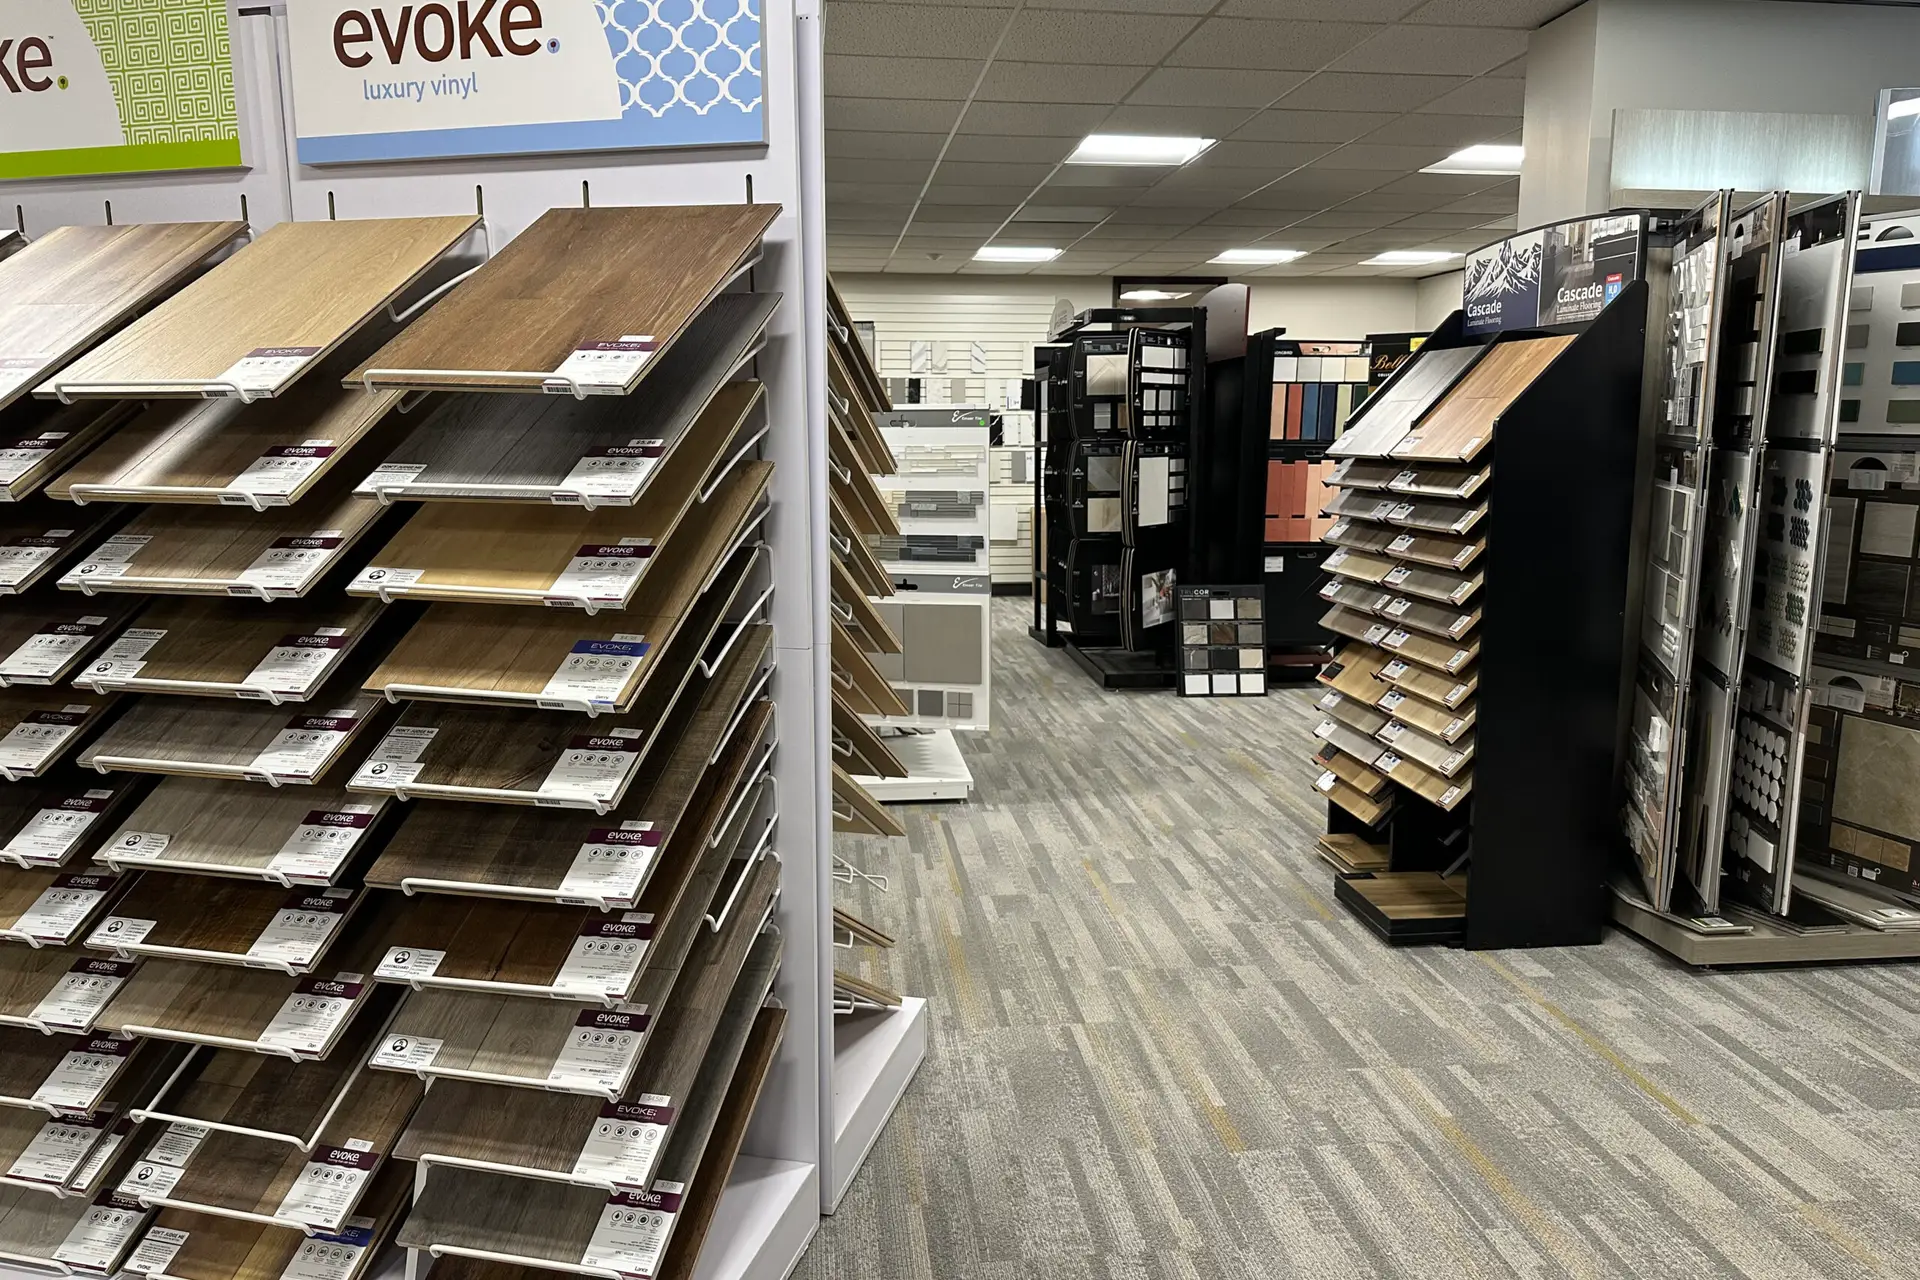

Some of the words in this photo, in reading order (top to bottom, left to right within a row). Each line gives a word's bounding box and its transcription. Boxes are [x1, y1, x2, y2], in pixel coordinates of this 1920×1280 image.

[363, 79, 426, 103] luxury
[430, 71, 478, 100] vinyl
[1557, 281, 1603, 303] Cascade
[1467, 299, 1502, 318] Cascade
[1556, 303, 1579, 314] Laminate
[1580, 299, 1602, 311] Flooring
[1467, 319, 1484, 327] Laminate
[1484, 316, 1502, 326] Flooring
